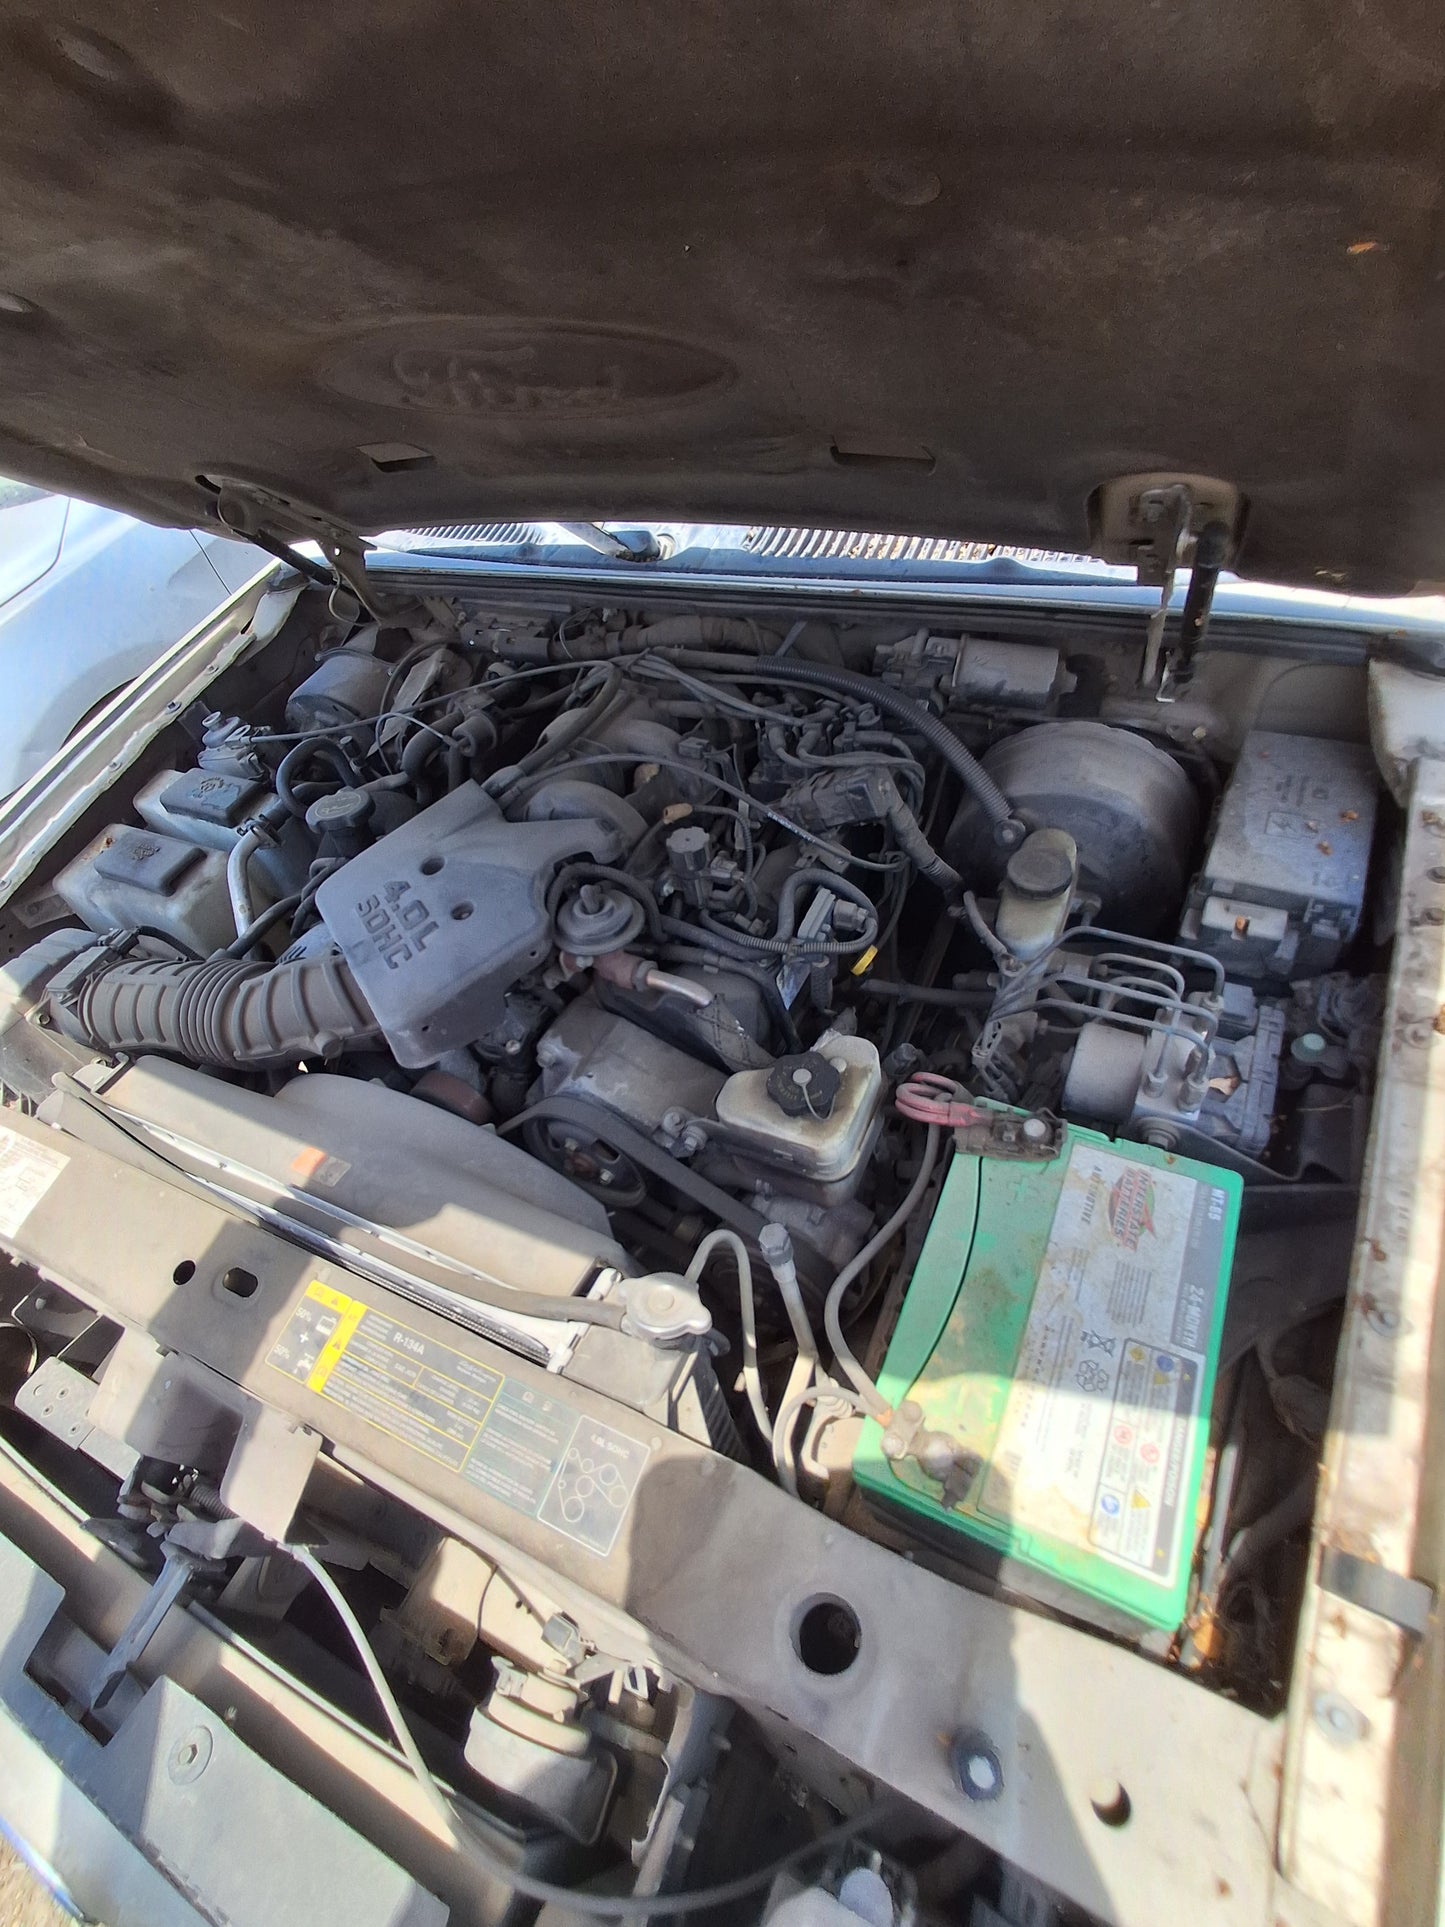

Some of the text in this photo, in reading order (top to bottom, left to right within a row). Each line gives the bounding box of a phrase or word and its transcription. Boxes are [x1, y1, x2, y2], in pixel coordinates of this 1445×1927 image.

[355, 894, 413, 970] SOHC
[383, 880, 440, 953] 4.0L
[1080, 1165, 1103, 1225] AUTOMOTIVE
[1114, 1169, 1136, 1239] BATTERIES
[1126, 1169, 1150, 1251] INTERSTATE
[295, 1307, 312, 1323] 50%
[392, 1332, 426, 1356] R-134A
[273, 1344, 290, 1360] 50%
